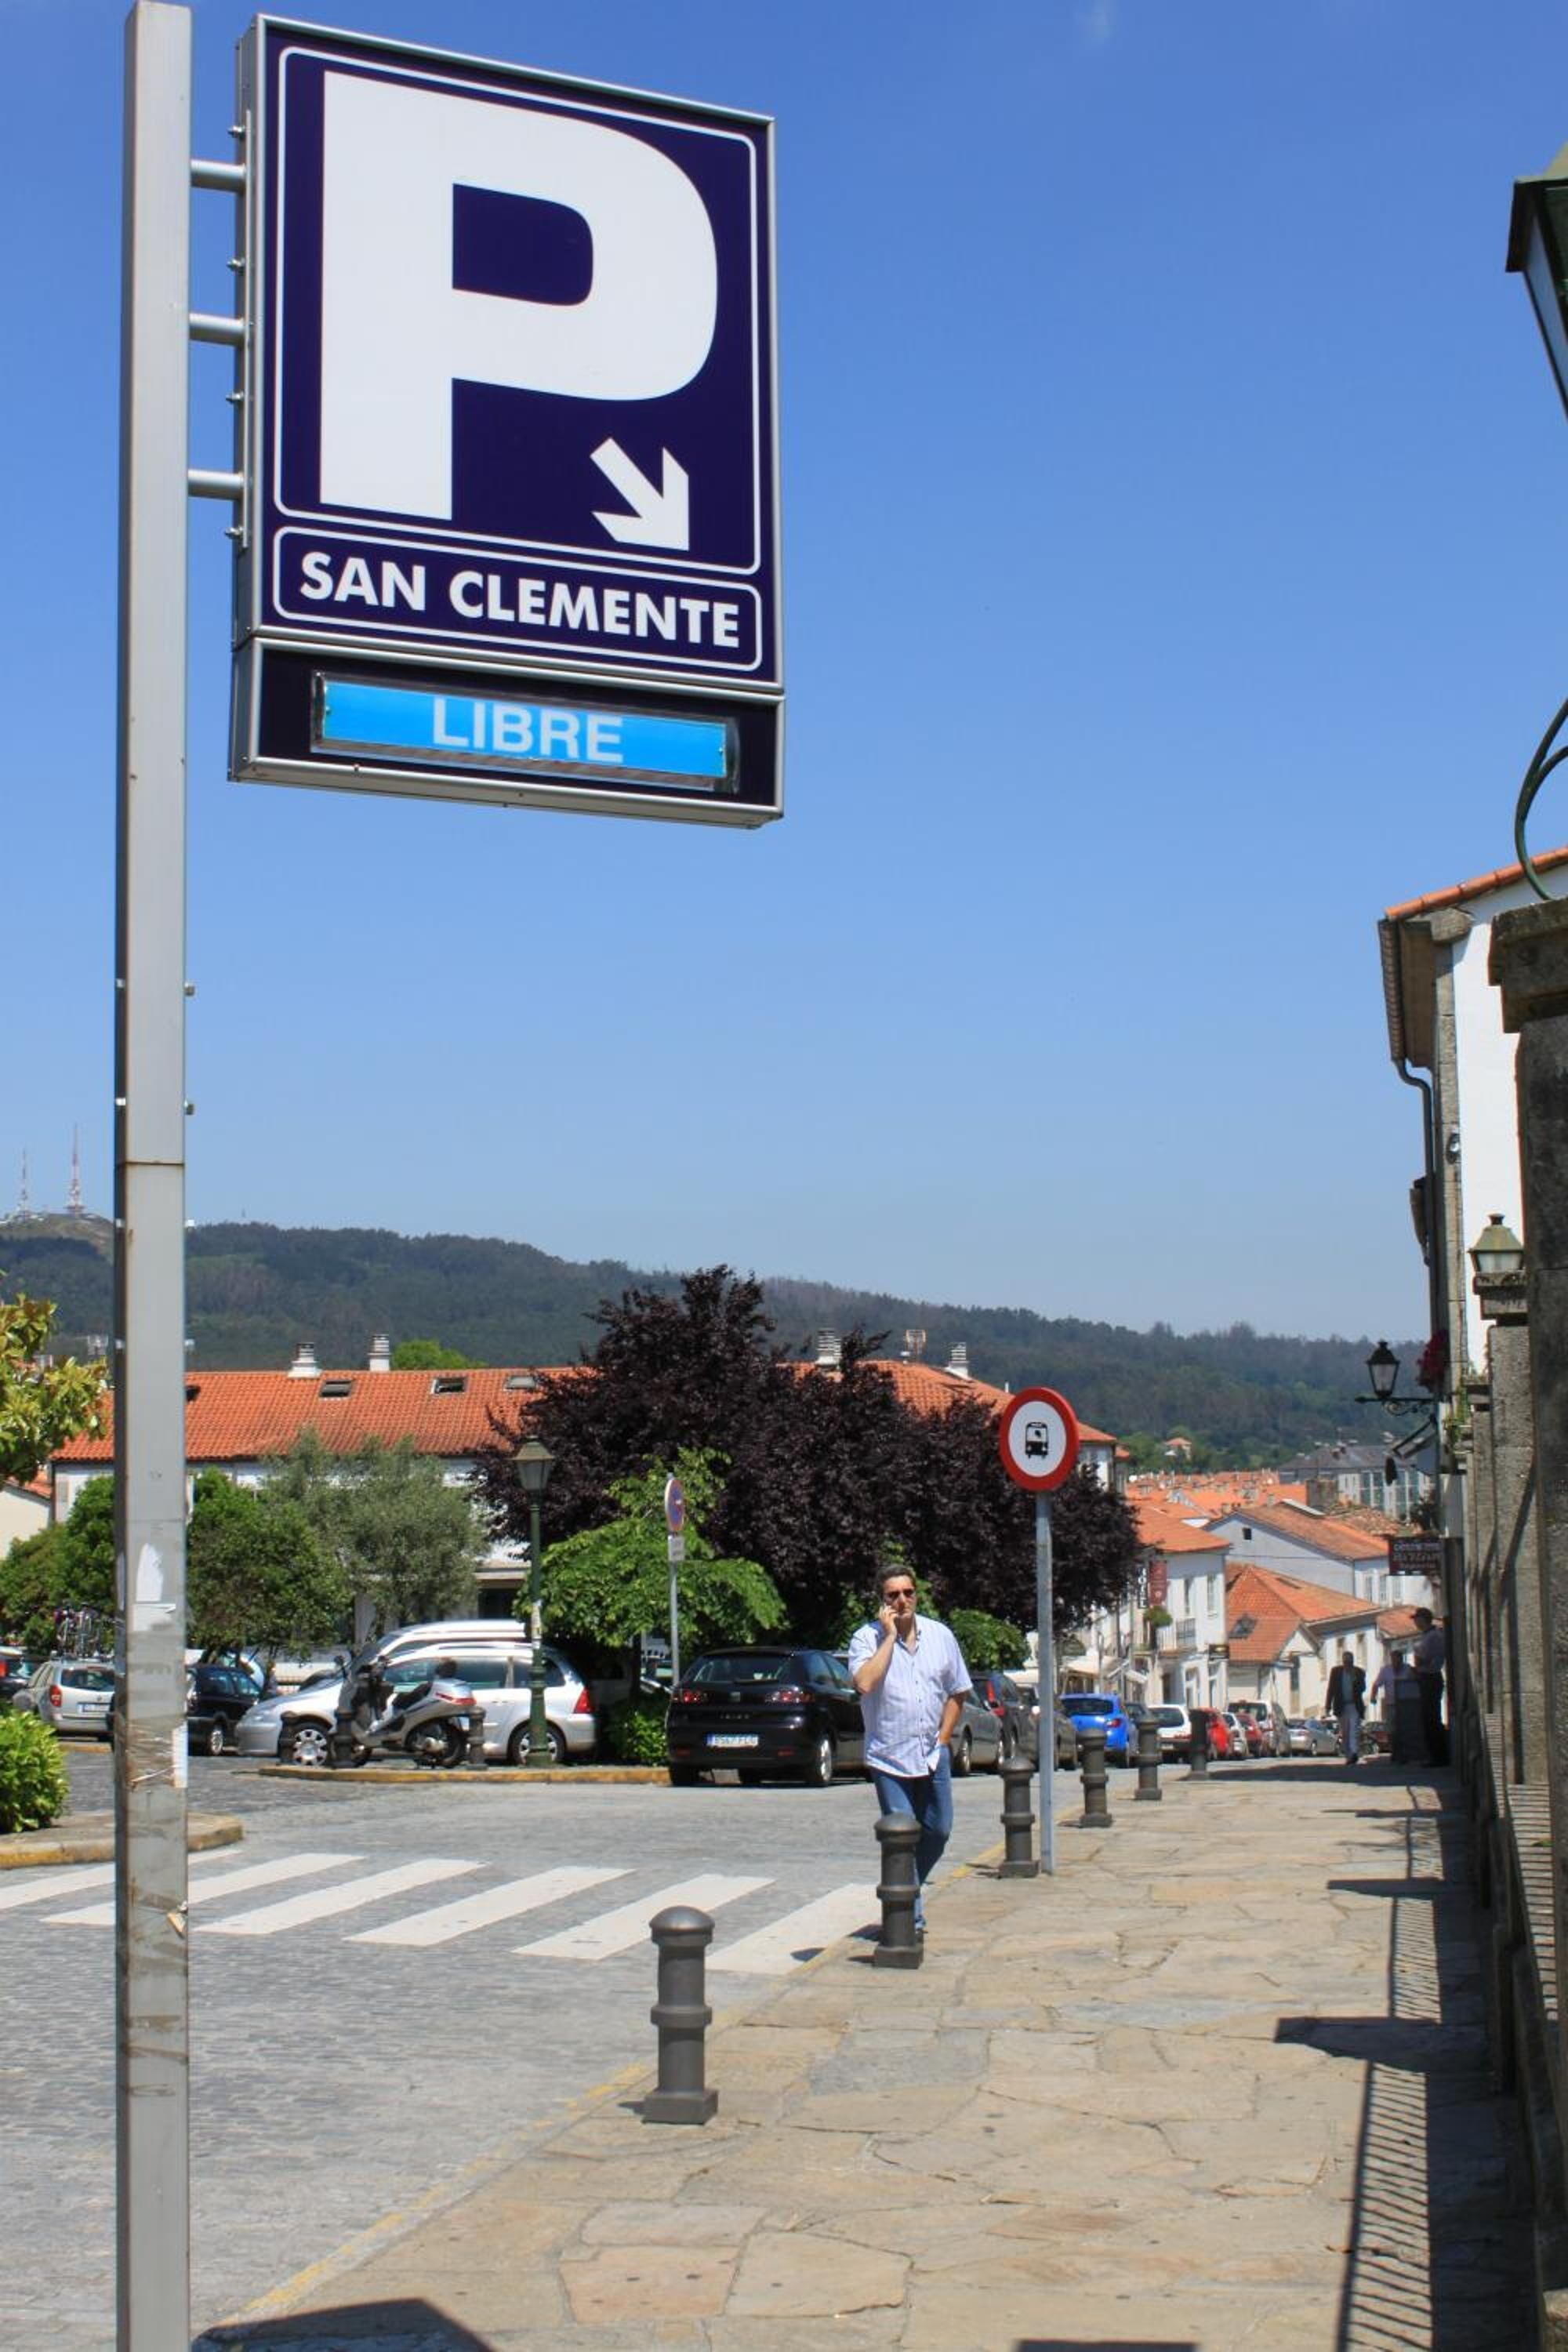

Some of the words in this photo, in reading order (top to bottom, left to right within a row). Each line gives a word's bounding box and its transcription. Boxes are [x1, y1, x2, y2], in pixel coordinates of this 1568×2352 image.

[320, 70, 718, 521] P
[299, 551, 426, 611] SAN
[448, 570, 740, 648] CLEMENTE
[432, 696, 624, 764] LIBRE
